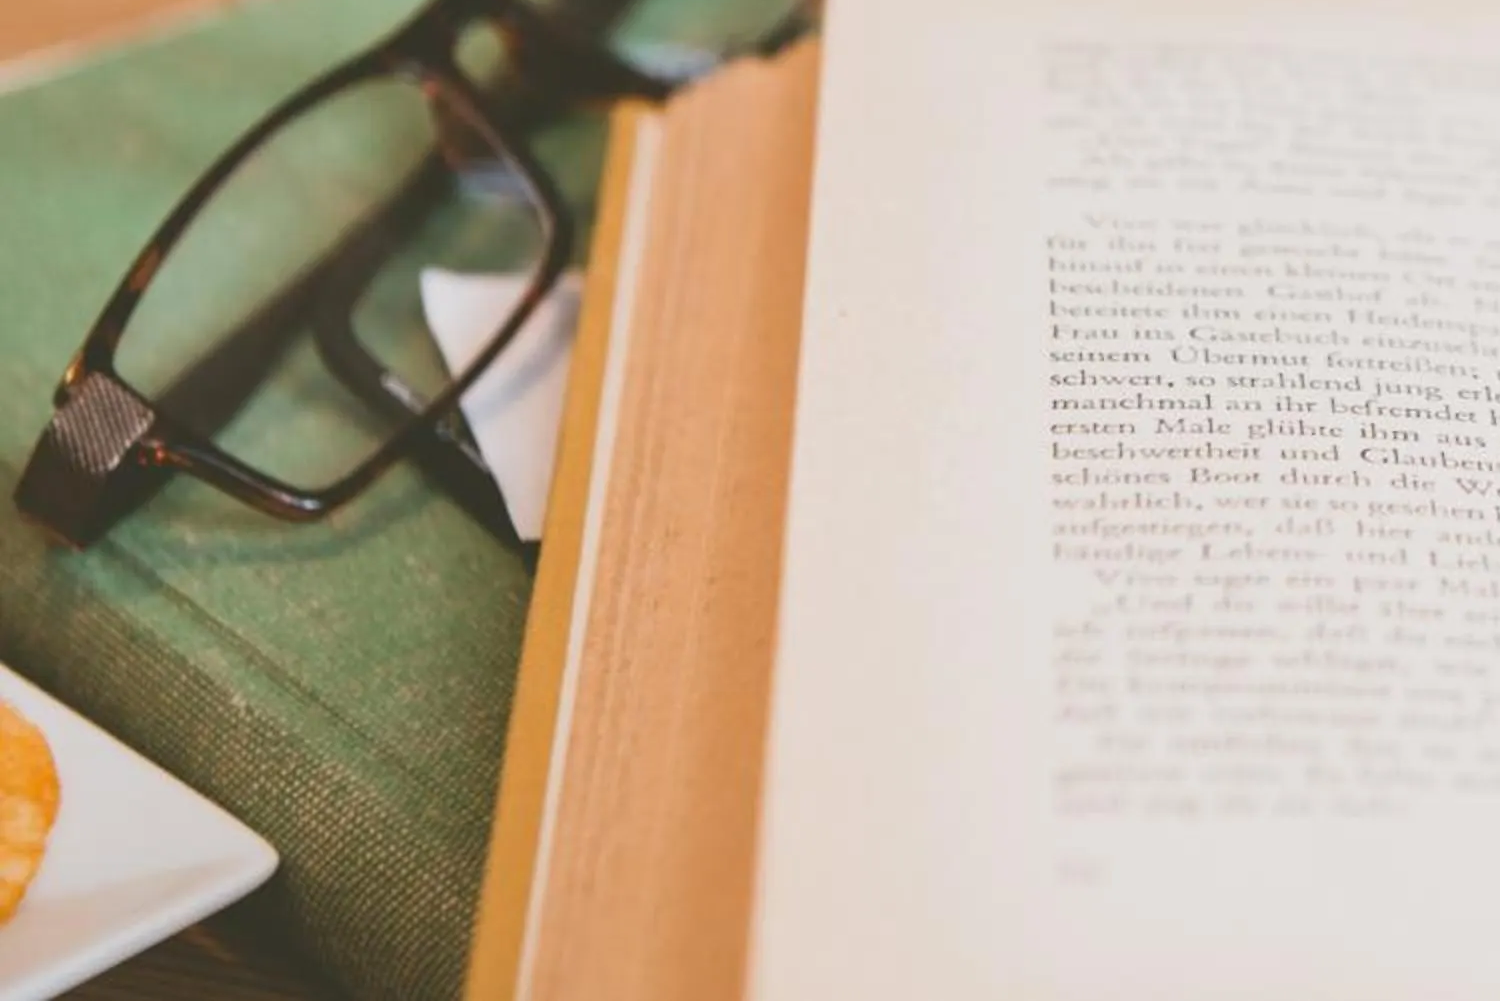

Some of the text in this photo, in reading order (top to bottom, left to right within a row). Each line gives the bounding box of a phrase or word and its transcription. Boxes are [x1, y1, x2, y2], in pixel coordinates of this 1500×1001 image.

[1052, 324, 1118, 340] Frau
[1134, 327, 1176, 341] ins
[1049, 349, 1151, 363] seinem
[1170, 345, 1309, 367] Übermut
[1049, 369, 1175, 389] schwert,
[1185, 375, 1216, 387] so
[1226, 371, 1361, 392] strahlend
[1374, 377, 1443, 401] jung
[1050, 393, 1212, 411] manchmal
[1225, 399, 1263, 411] an
[1275, 395, 1319, 413] ihr
[1330, 397, 1478, 424] befremdet
[1050, 422, 1136, 435] ersten
[1154, 417, 1231, 435] Male
[1247, 418, 1344, 440] glühte
[1360, 421, 1420, 442] ihm
[1437, 431, 1486, 448] aus
[1052, 441, 1262, 461] beschwertheit
[1280, 444, 1341, 462] und
[1051, 467, 1172, 486] schönes
[1190, 467, 1261, 485] Boot
[1280, 467, 1371, 488] durch
[1391, 473, 1437, 492] die
